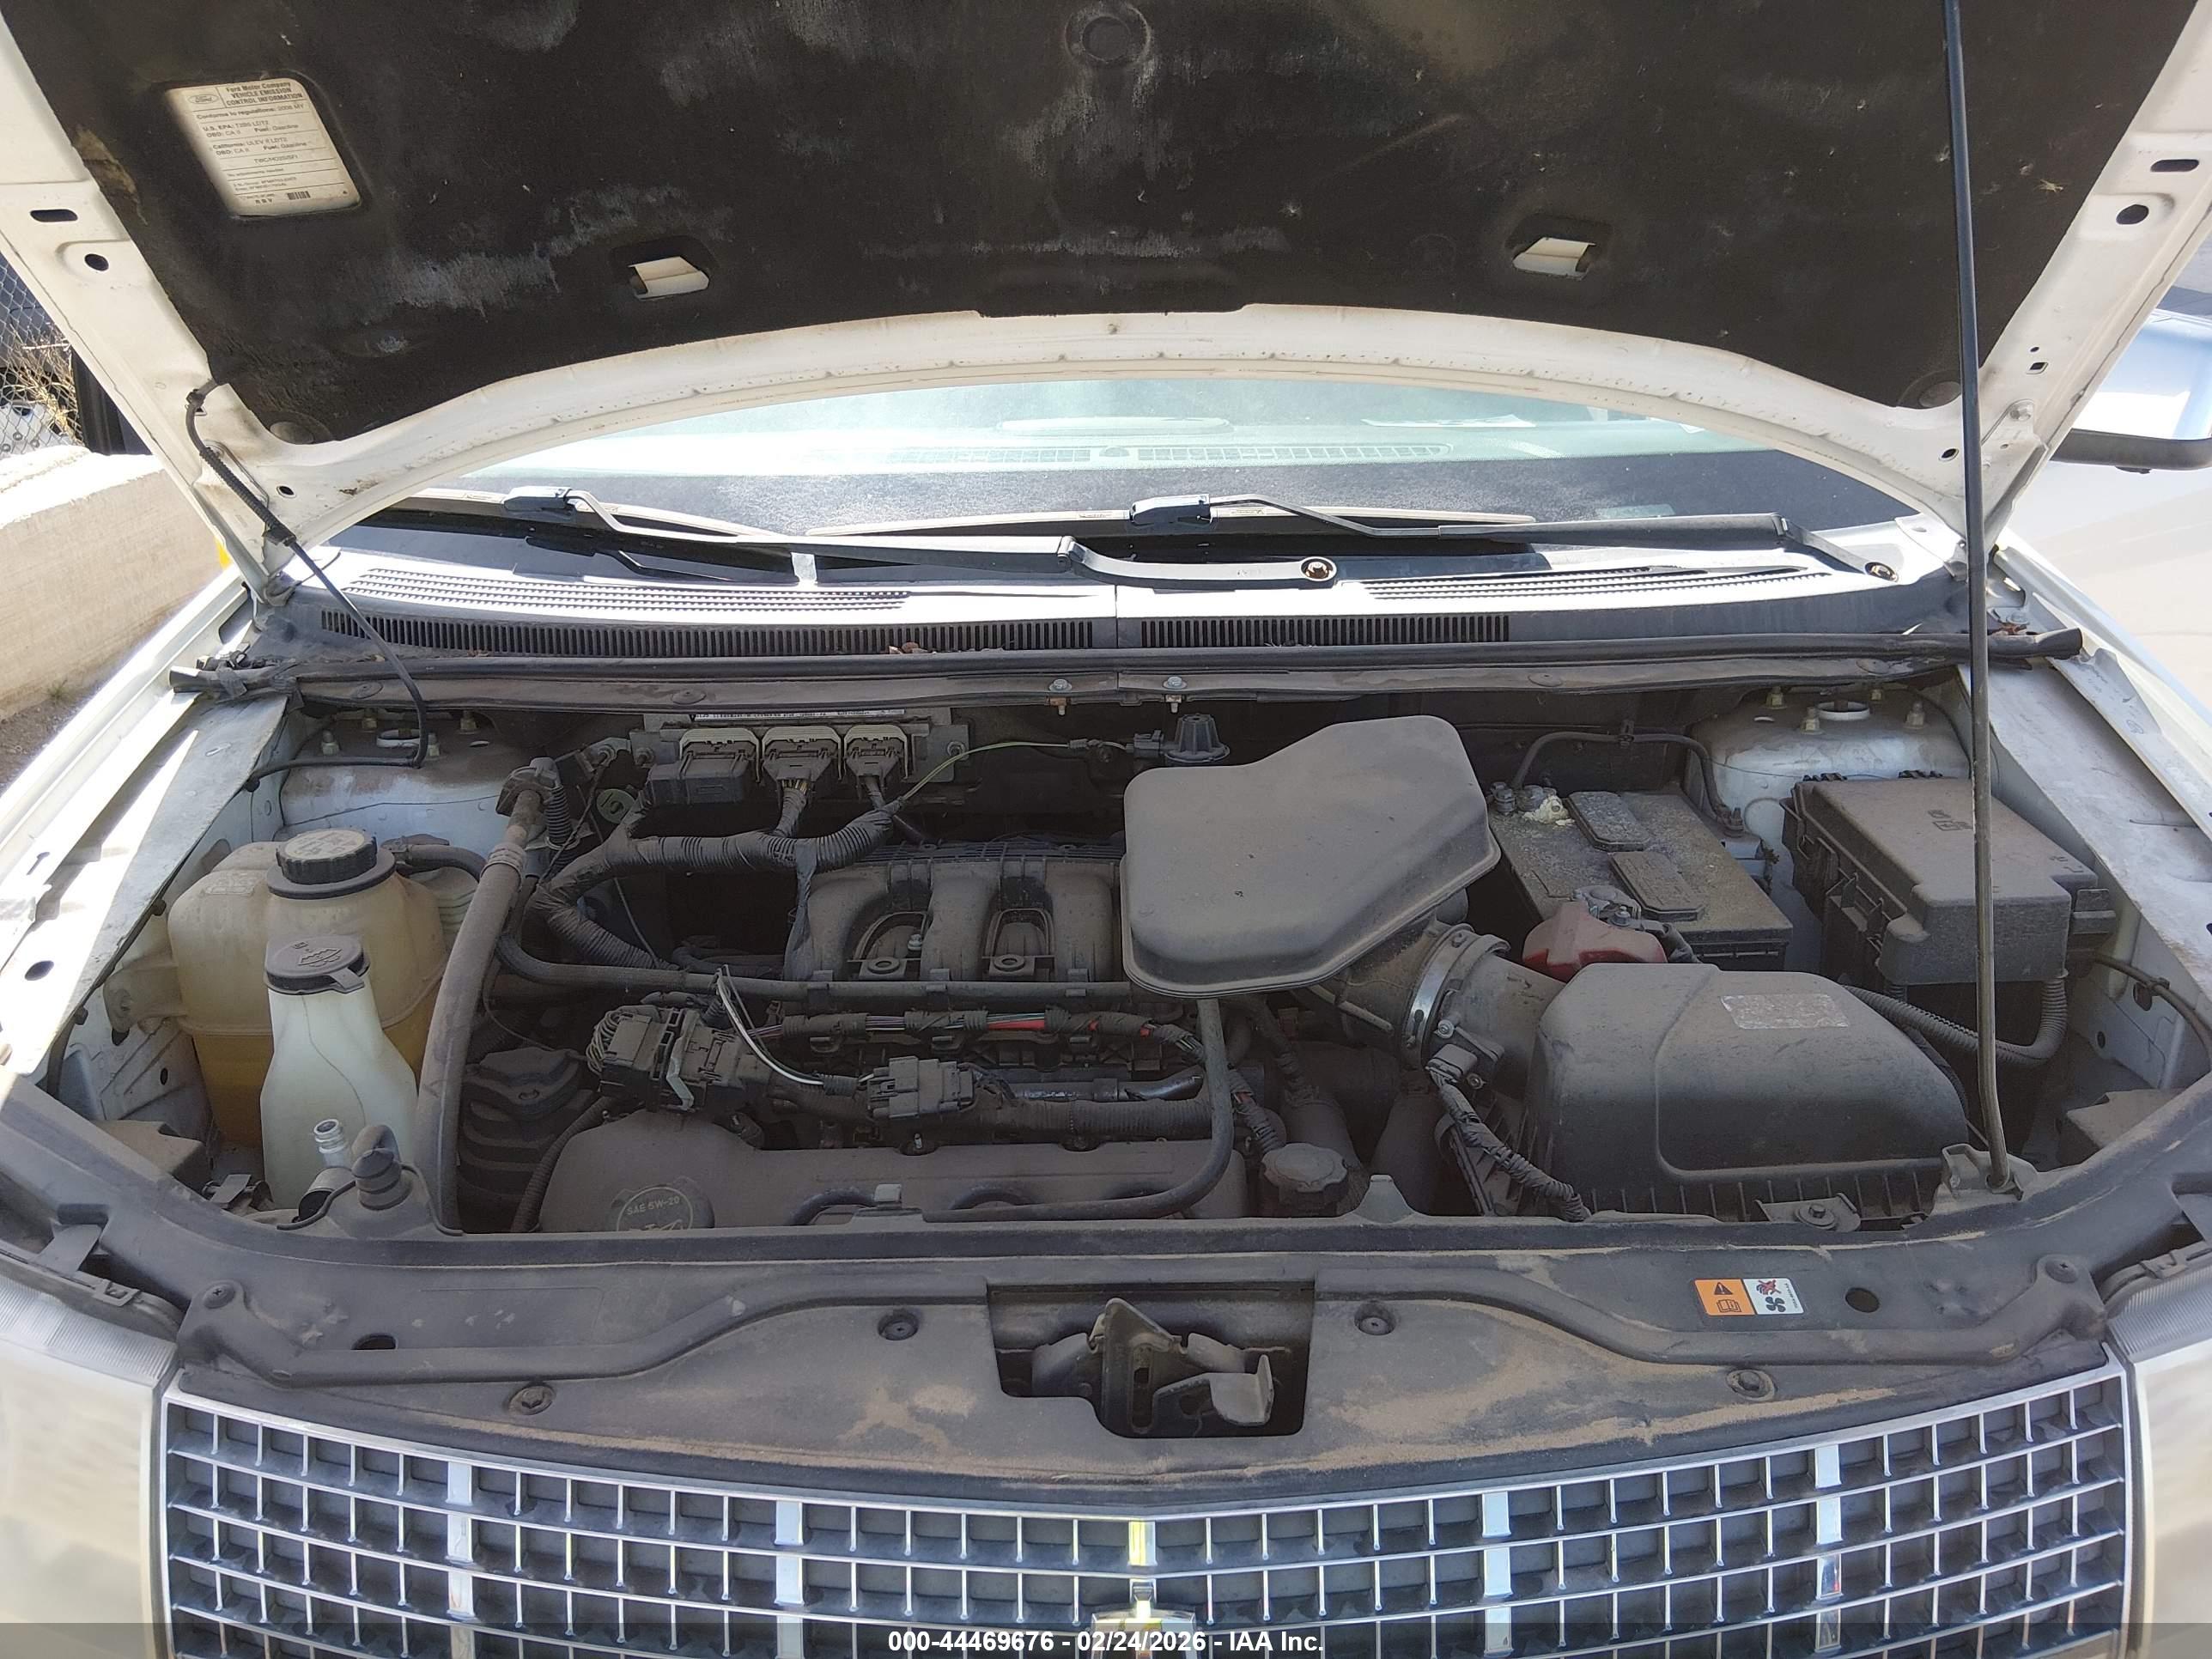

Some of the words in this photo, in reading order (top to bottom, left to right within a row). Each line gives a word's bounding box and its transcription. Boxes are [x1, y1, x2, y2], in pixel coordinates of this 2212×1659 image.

[231, 90, 258, 99] VEHICLE
[258, 93, 302, 102] INFORMATION
[626, 1203, 647, 1216] SAE
[647, 1195, 680, 1210] 5W-20
